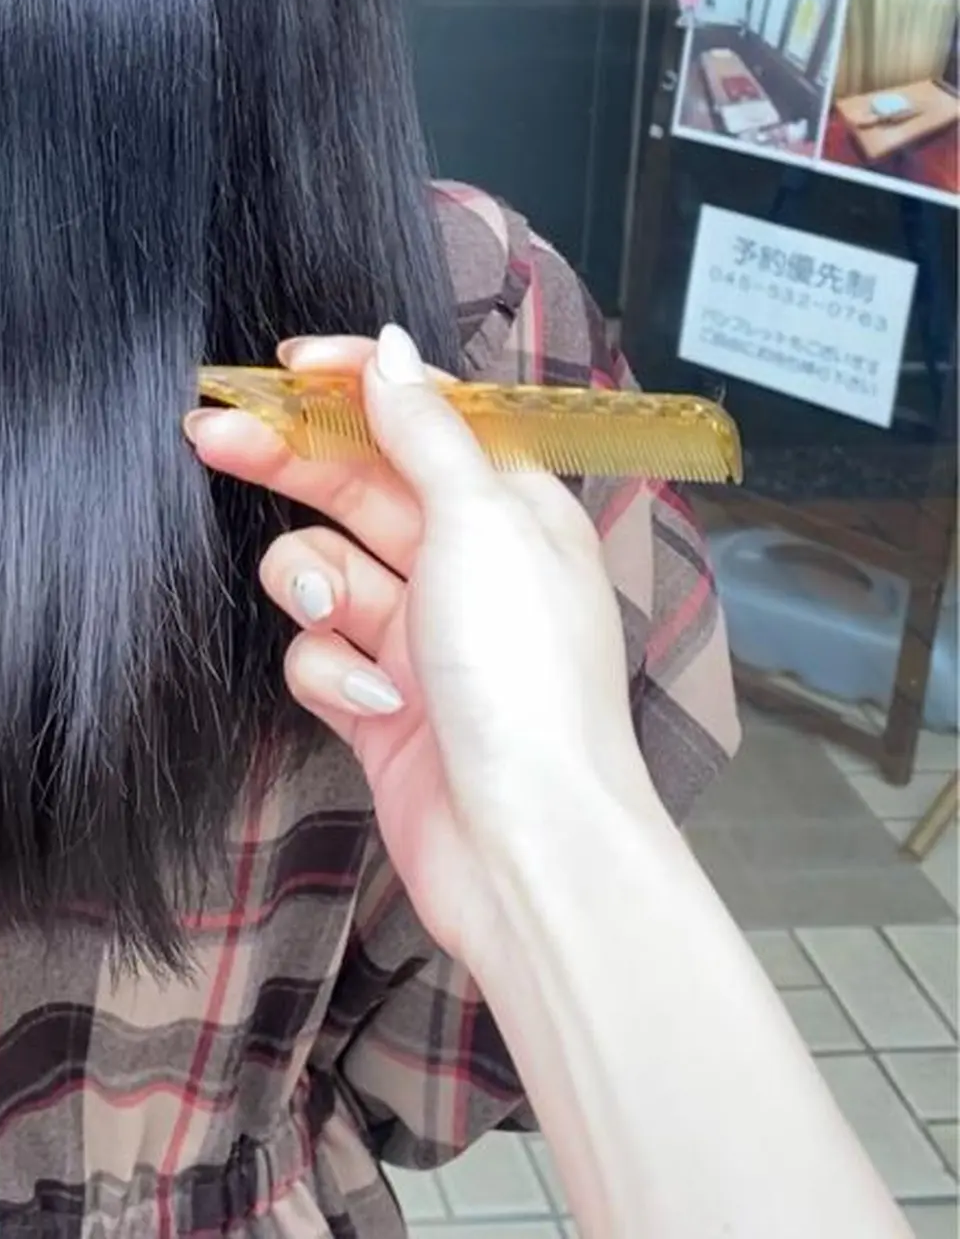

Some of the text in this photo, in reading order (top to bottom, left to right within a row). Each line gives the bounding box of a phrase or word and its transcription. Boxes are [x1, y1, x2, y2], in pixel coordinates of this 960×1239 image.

[732, 236, 876, 304] 予約優先制
